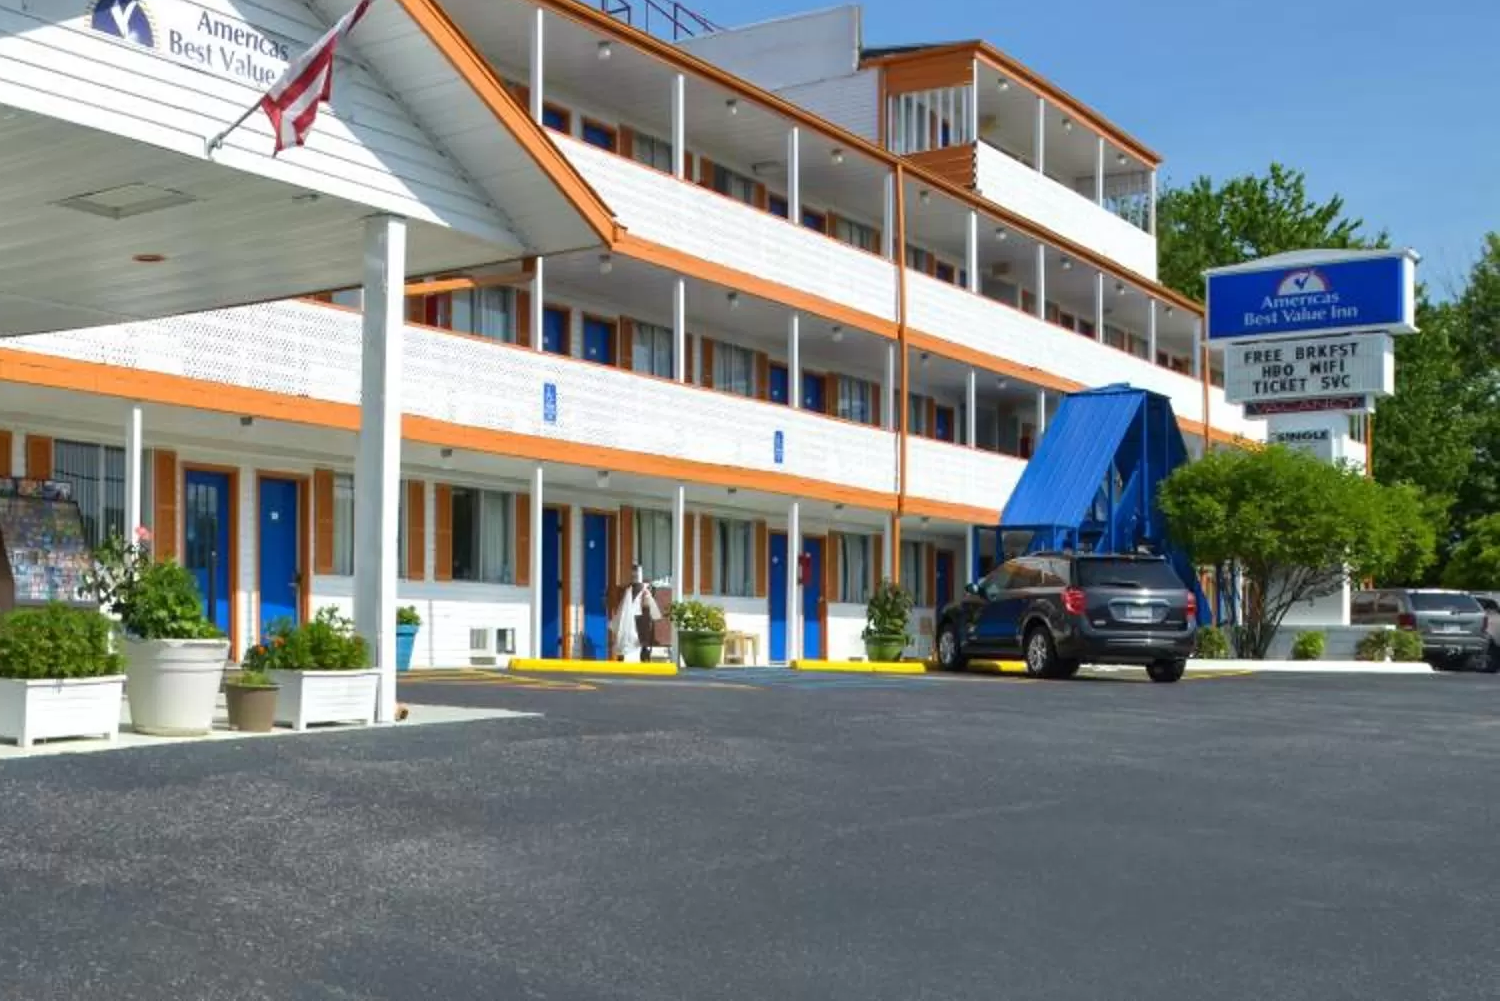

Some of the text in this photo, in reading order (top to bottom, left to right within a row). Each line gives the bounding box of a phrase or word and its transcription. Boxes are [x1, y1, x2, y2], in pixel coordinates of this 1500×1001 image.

[197, 10, 290, 62] Americas
[169, 29, 276, 85] Best Value
[1261, 291, 1340, 310] Americas
[1244, 305, 1359, 327] Best Value Inn
[1244, 349, 1283, 364] FREE
[1262, 359, 1345, 378] HBO WIFI
[1252, 374, 1350, 395] TICKET SVC
[1276, 429, 1329, 441] SINGLE
